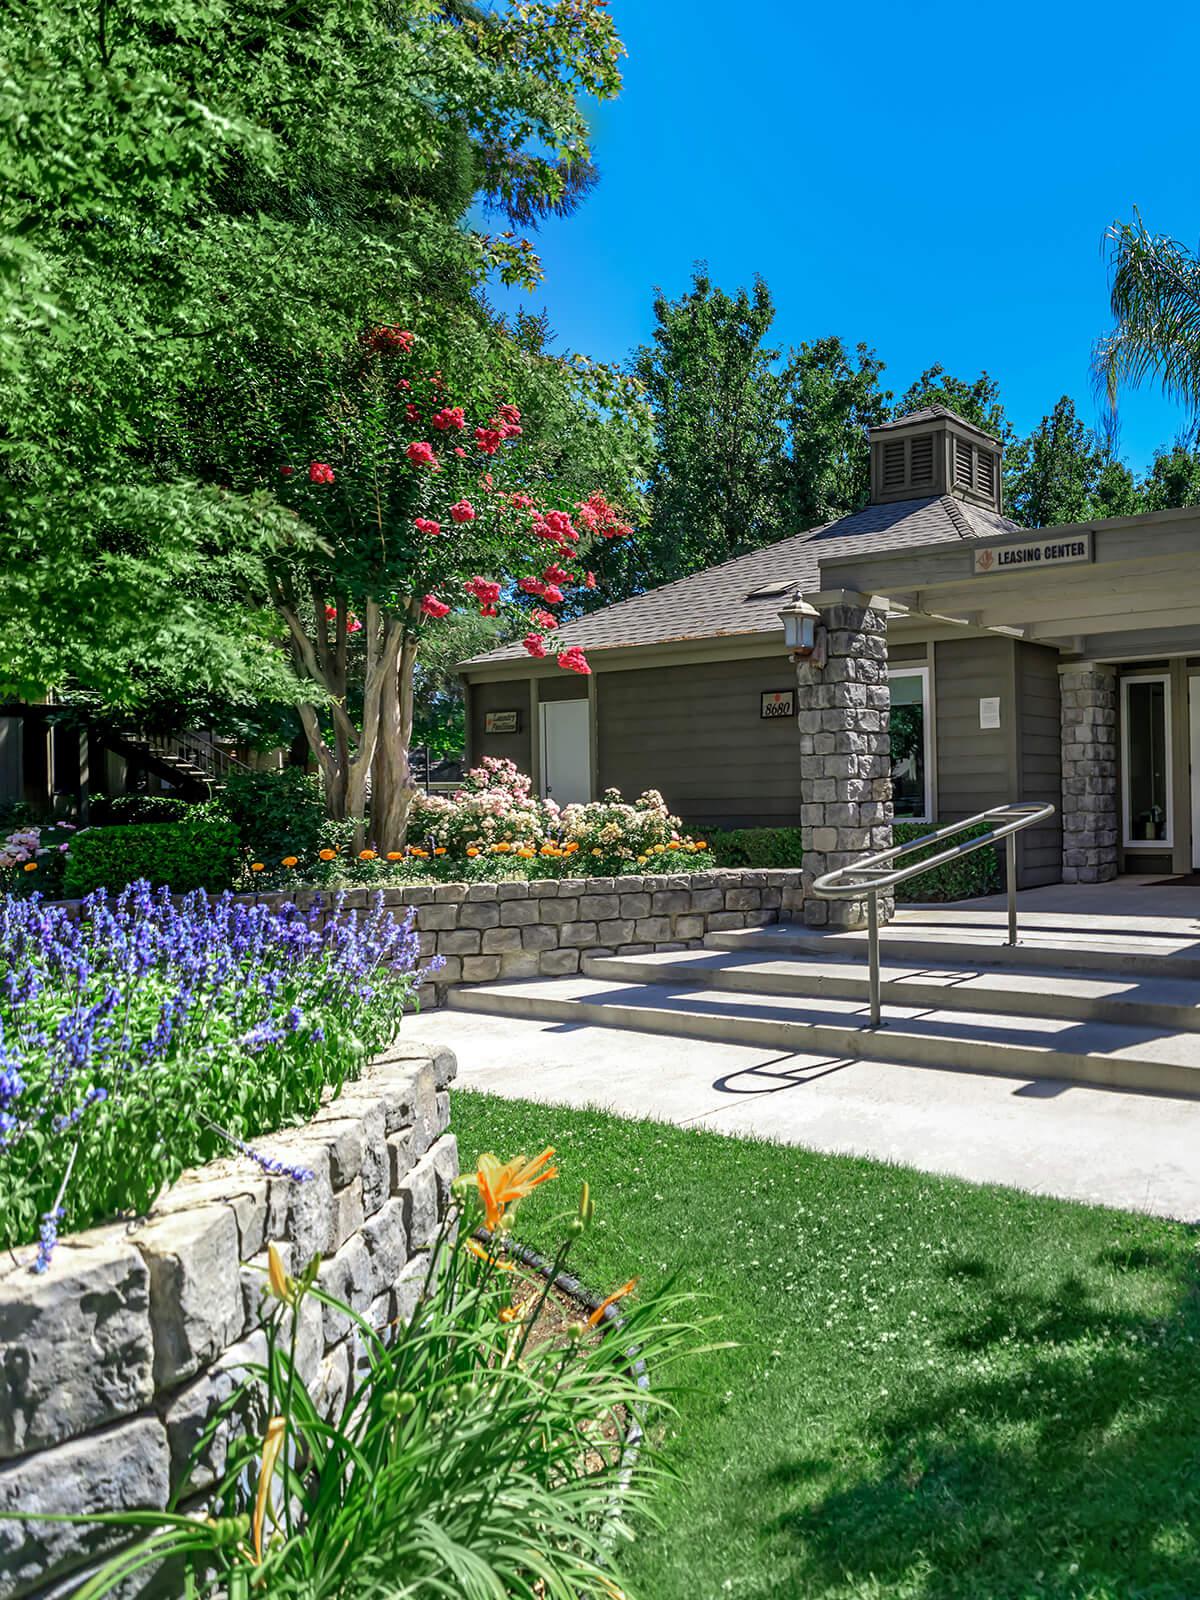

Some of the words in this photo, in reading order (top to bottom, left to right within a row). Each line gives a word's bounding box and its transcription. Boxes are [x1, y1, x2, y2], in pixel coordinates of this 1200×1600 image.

[998, 547, 1041, 565] LEASING
[1044, 542, 1085, 560] CENTER
[765, 702, 790, 717] 8680
